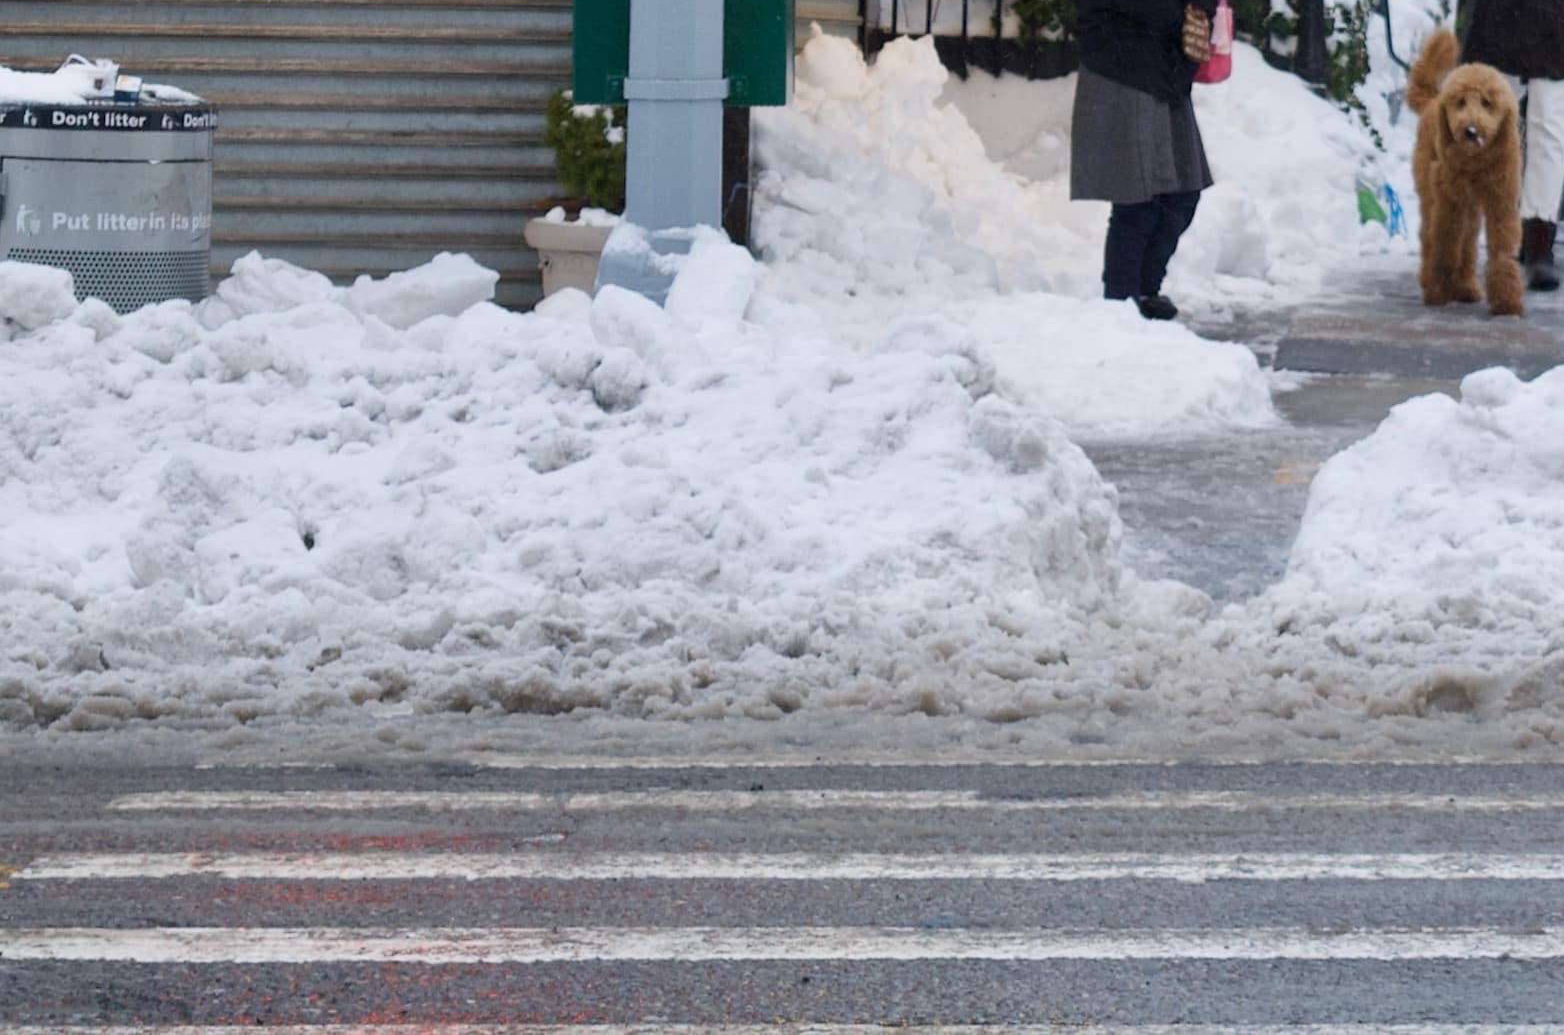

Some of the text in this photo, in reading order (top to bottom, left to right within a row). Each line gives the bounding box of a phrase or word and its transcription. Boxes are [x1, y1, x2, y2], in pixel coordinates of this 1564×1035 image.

[52, 111, 146, 128] Don't litter
[52, 212, 211, 233] Put litter in its pla
